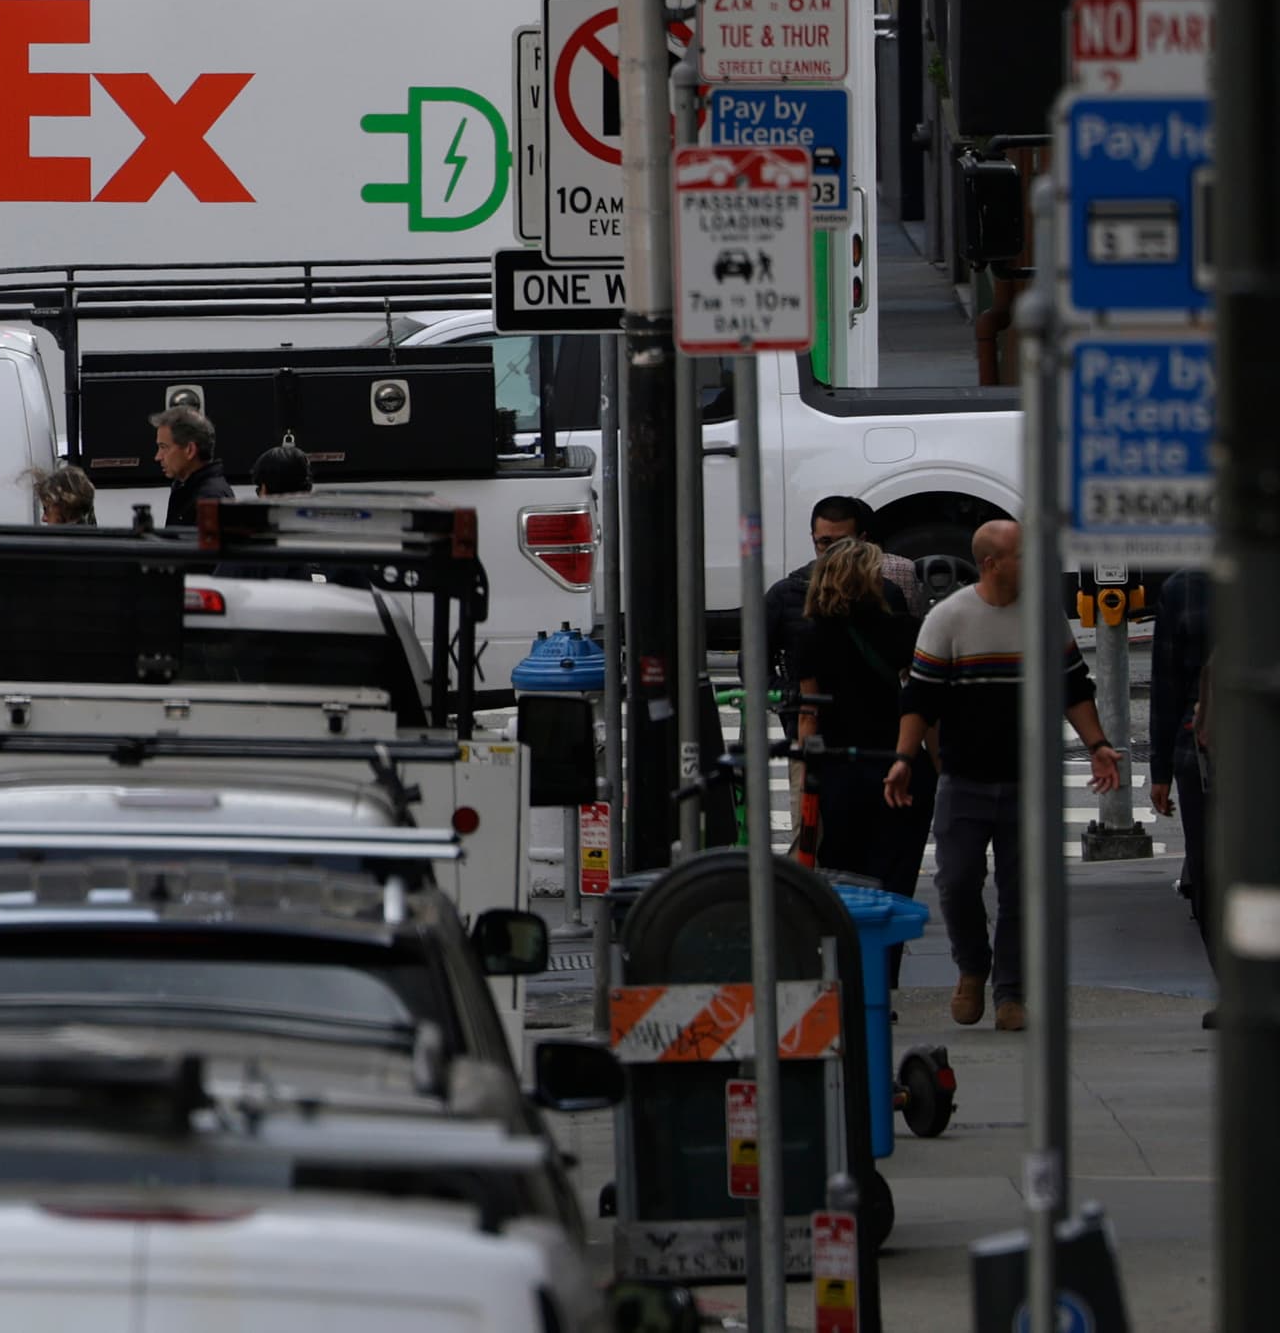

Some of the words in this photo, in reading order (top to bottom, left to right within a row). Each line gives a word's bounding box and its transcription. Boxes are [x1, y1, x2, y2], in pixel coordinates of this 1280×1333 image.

[720, 24, 753, 48] TUE
[760, 24, 775, 48] &
[782, 24, 829, 48] THUR
[1075, 0, 1137, 57] NO
[718, 60, 764, 75] STREET
[770, 60, 832, 75] CLEANING
[720, 95, 765, 125] Pay
[772, 95, 808, 125] by
[720, 121, 815, 146] License
[1075, 114, 1163, 171] Pay
[684, 195, 799, 211] PASSENGER
[699, 215, 786, 232] LOADING
[523, 274, 591, 305] ONE
[714, 317, 773, 333] DAILY
[1080, 347, 1161, 397] Pay
[1080, 432, 1189, 474] Plate
